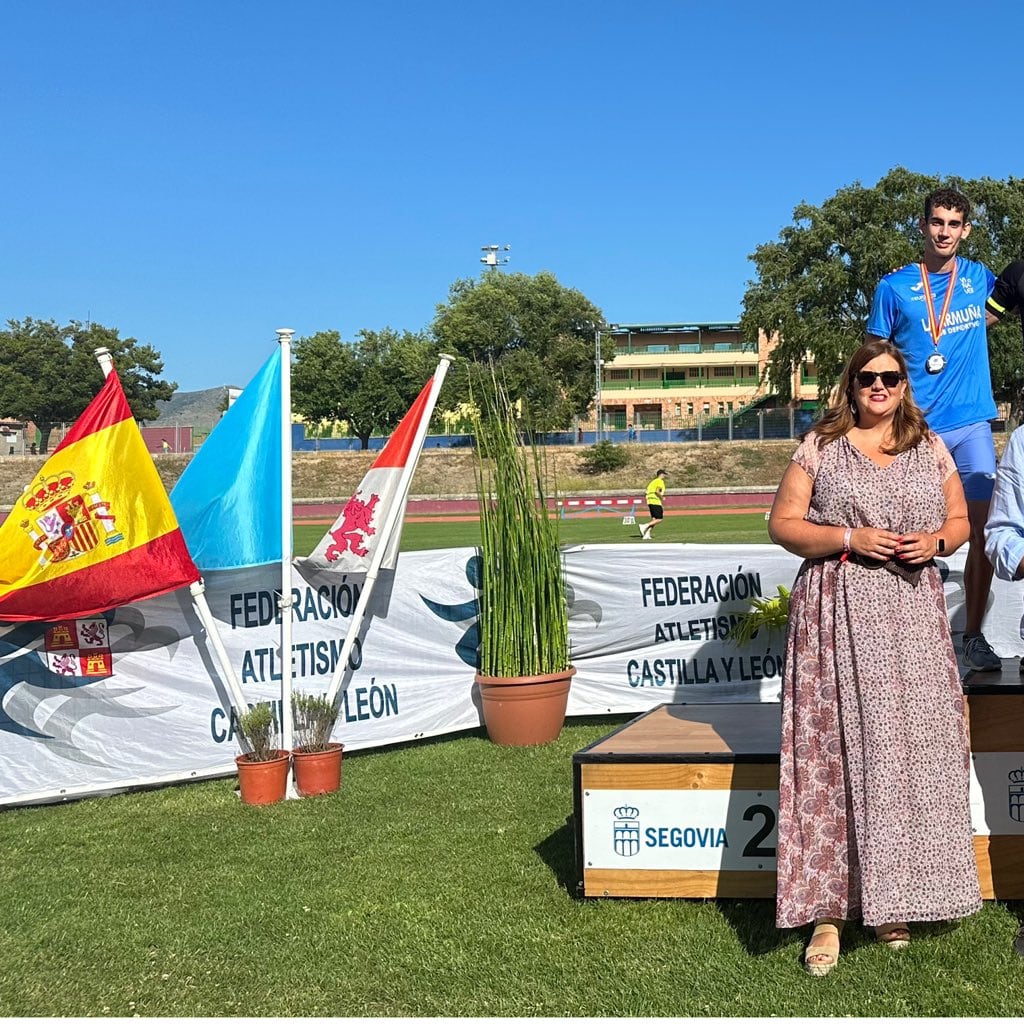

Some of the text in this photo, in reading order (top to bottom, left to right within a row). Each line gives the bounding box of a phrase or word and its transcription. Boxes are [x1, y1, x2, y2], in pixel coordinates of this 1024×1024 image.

[939, 303, 982, 328] RMUÑA
[641, 565, 762, 608] FEDERACIÓN
[654, 612, 759, 643] ATLETISM
[627, 656, 719, 688] CASTILLA
[721, 657, 734, 682] Y
[343, 677, 399, 723] LEÓN
[645, 827, 729, 849] SEGOVIA
[741, 804, 776, 858] 2
